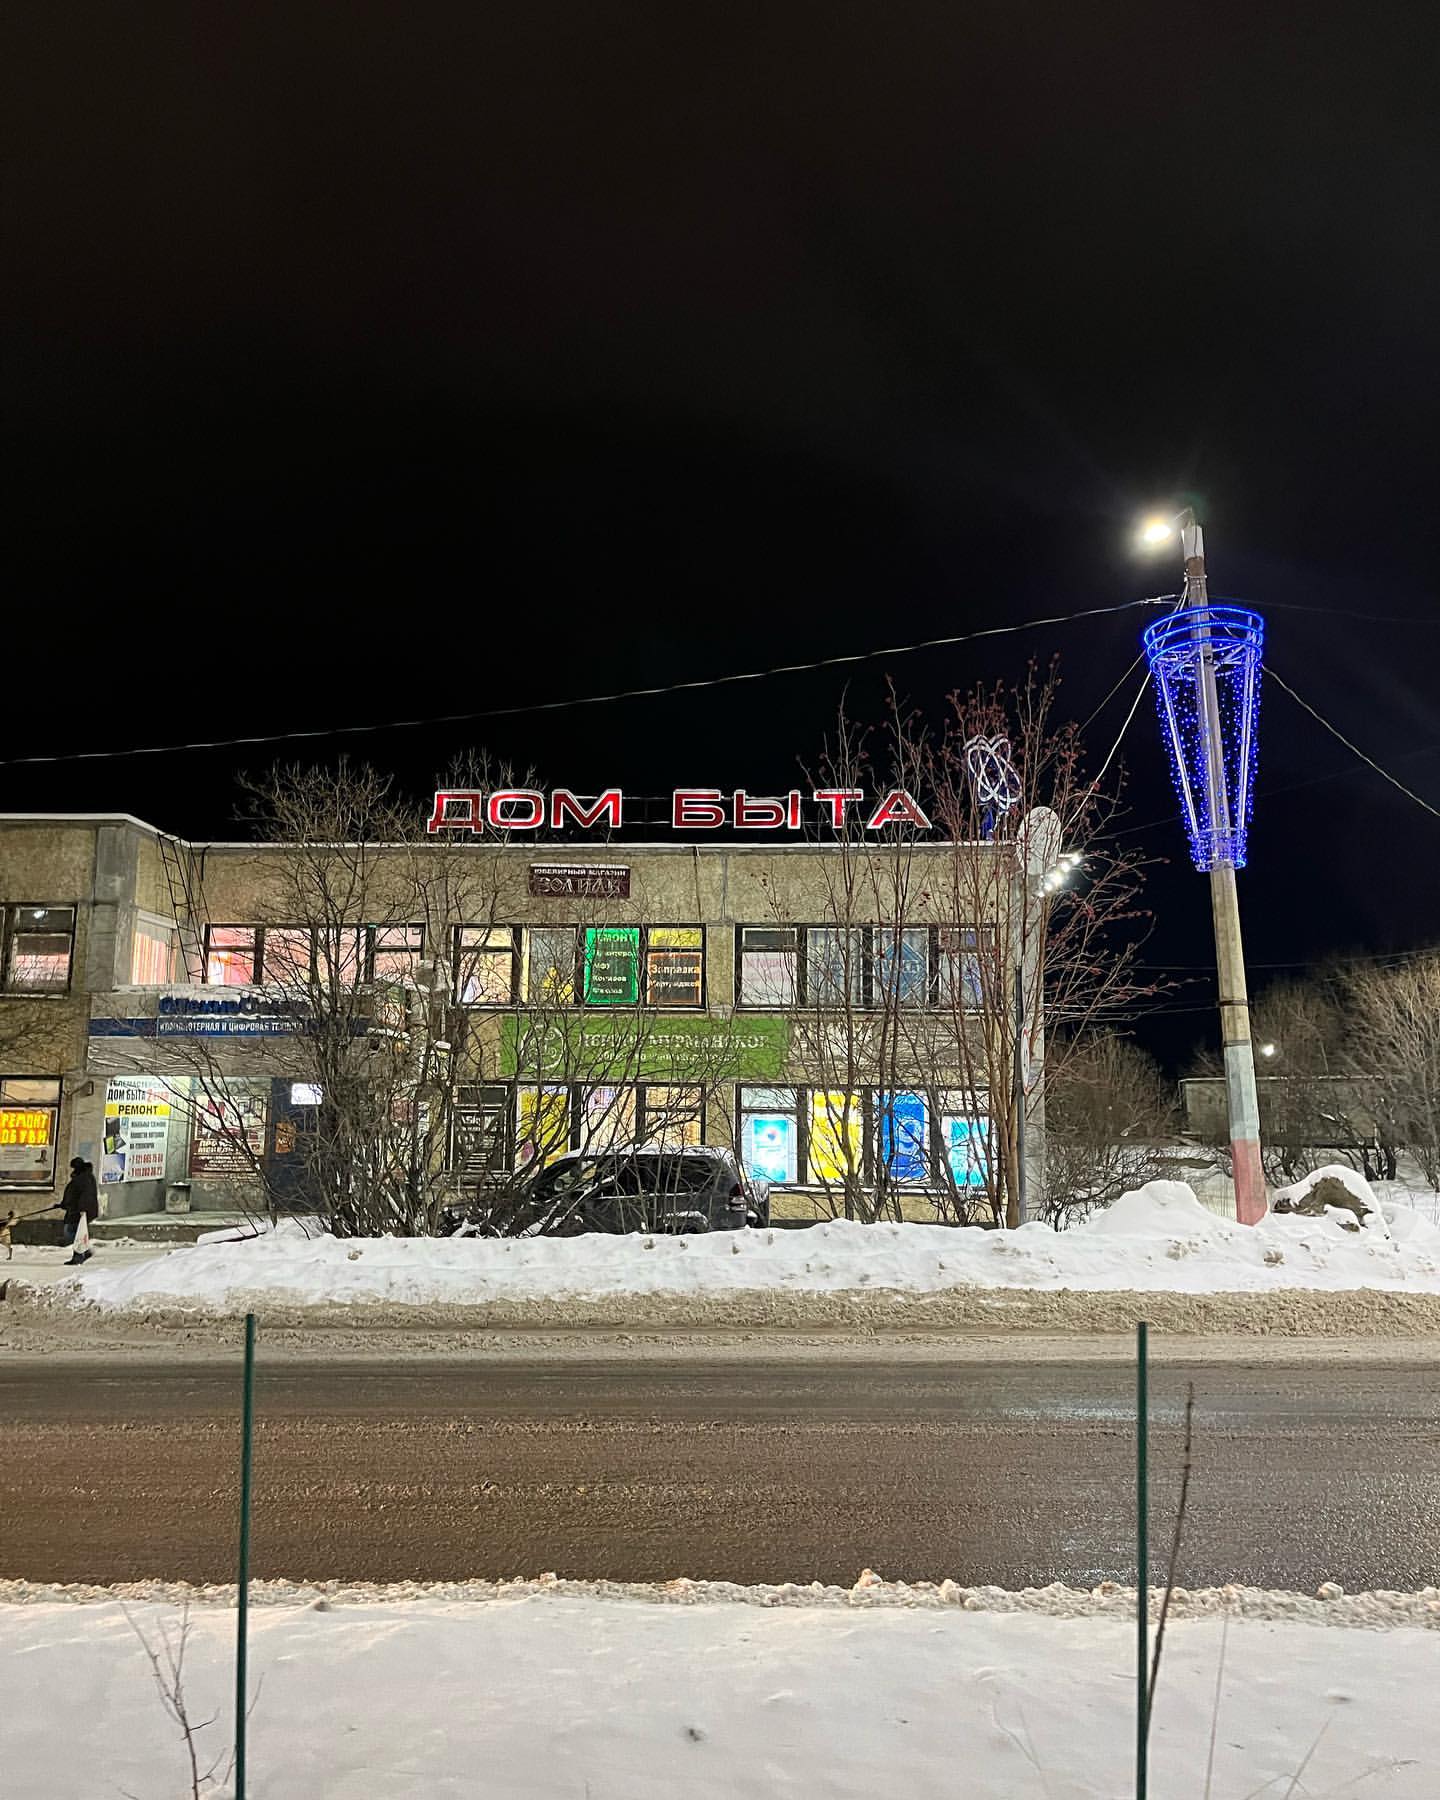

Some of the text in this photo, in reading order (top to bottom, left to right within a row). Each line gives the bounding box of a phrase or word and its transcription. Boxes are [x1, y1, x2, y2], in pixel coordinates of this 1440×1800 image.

[427, 788, 933, 834] ДОМ БЫТА
[534, 868, 586, 876] ЮВЕЛИРНЫЙ
[651, 964, 700, 976] Заправка
[229, 1021, 269, 1032] ЦИФРОВАЯ
[107, 1088, 125, 1102] ДОМ
[118, 1104, 159, 1115] РЕМОНТ
[1, 1111, 49, 1129] РЕМОНТ
[1, 1128, 48, 1144] ОБУВИ
